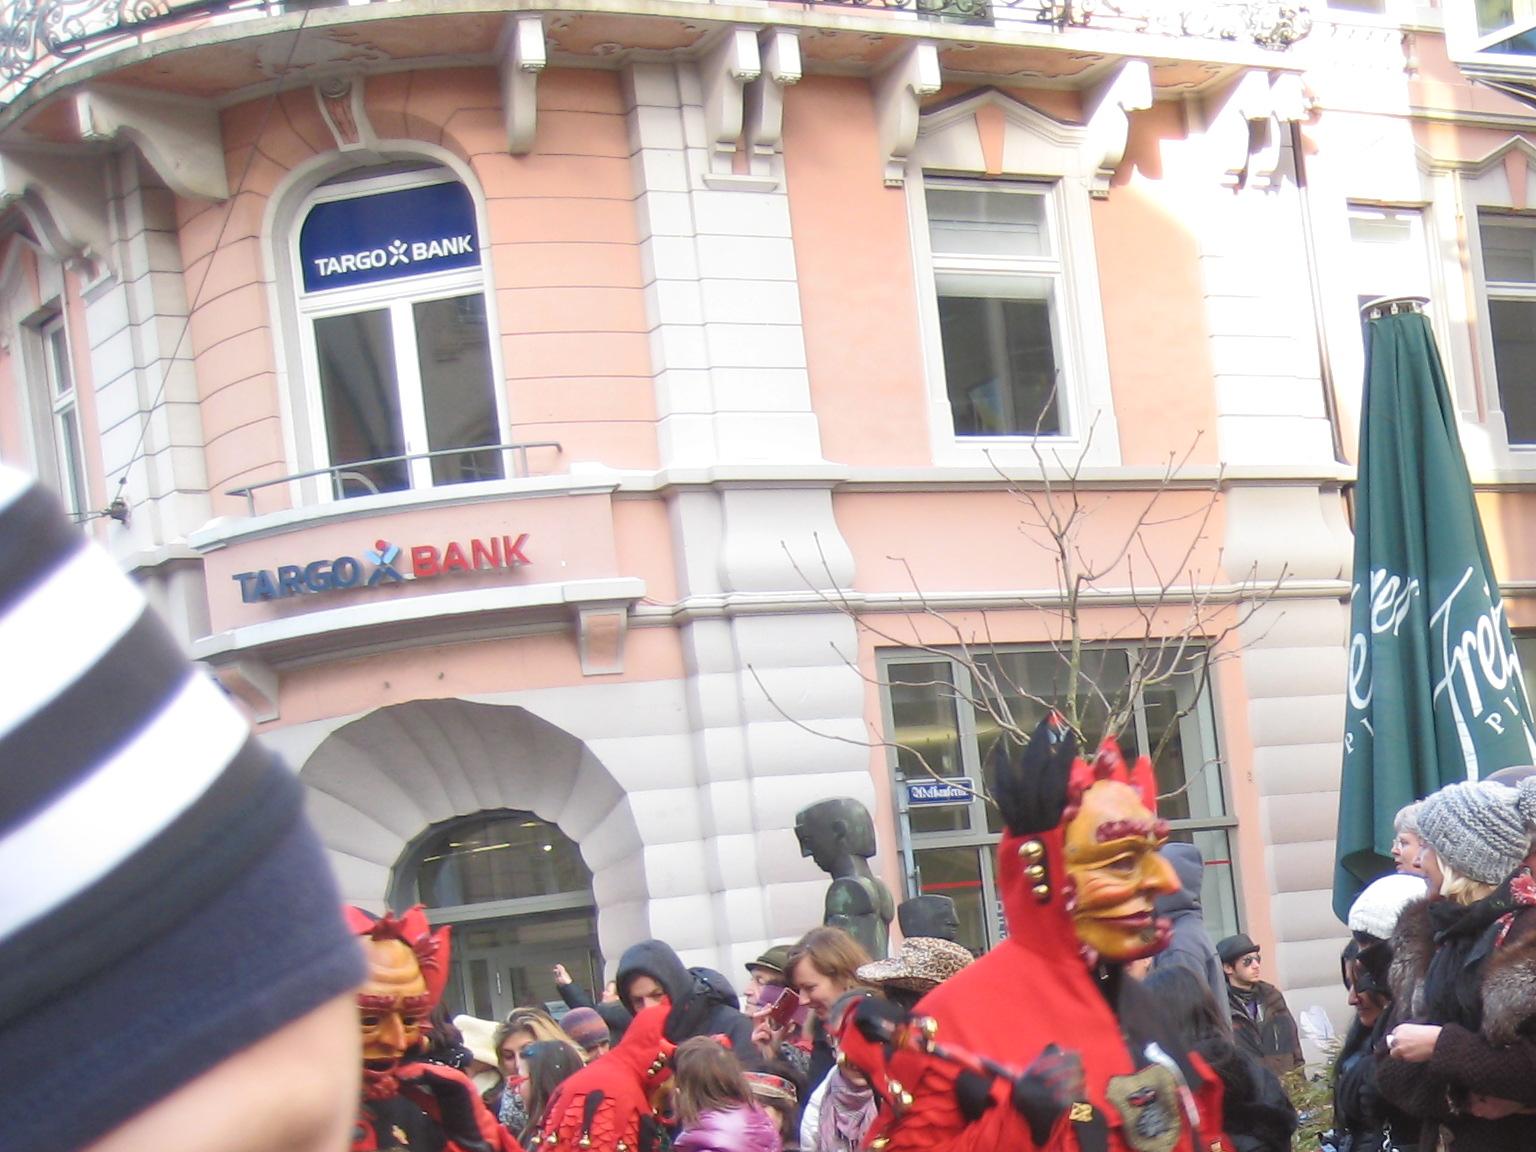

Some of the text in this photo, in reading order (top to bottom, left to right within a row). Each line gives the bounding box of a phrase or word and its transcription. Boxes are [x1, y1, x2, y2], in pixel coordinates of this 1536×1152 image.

[314, 234, 473, 276] TARGO BANK
[232, 533, 533, 604] TARGO BANK
